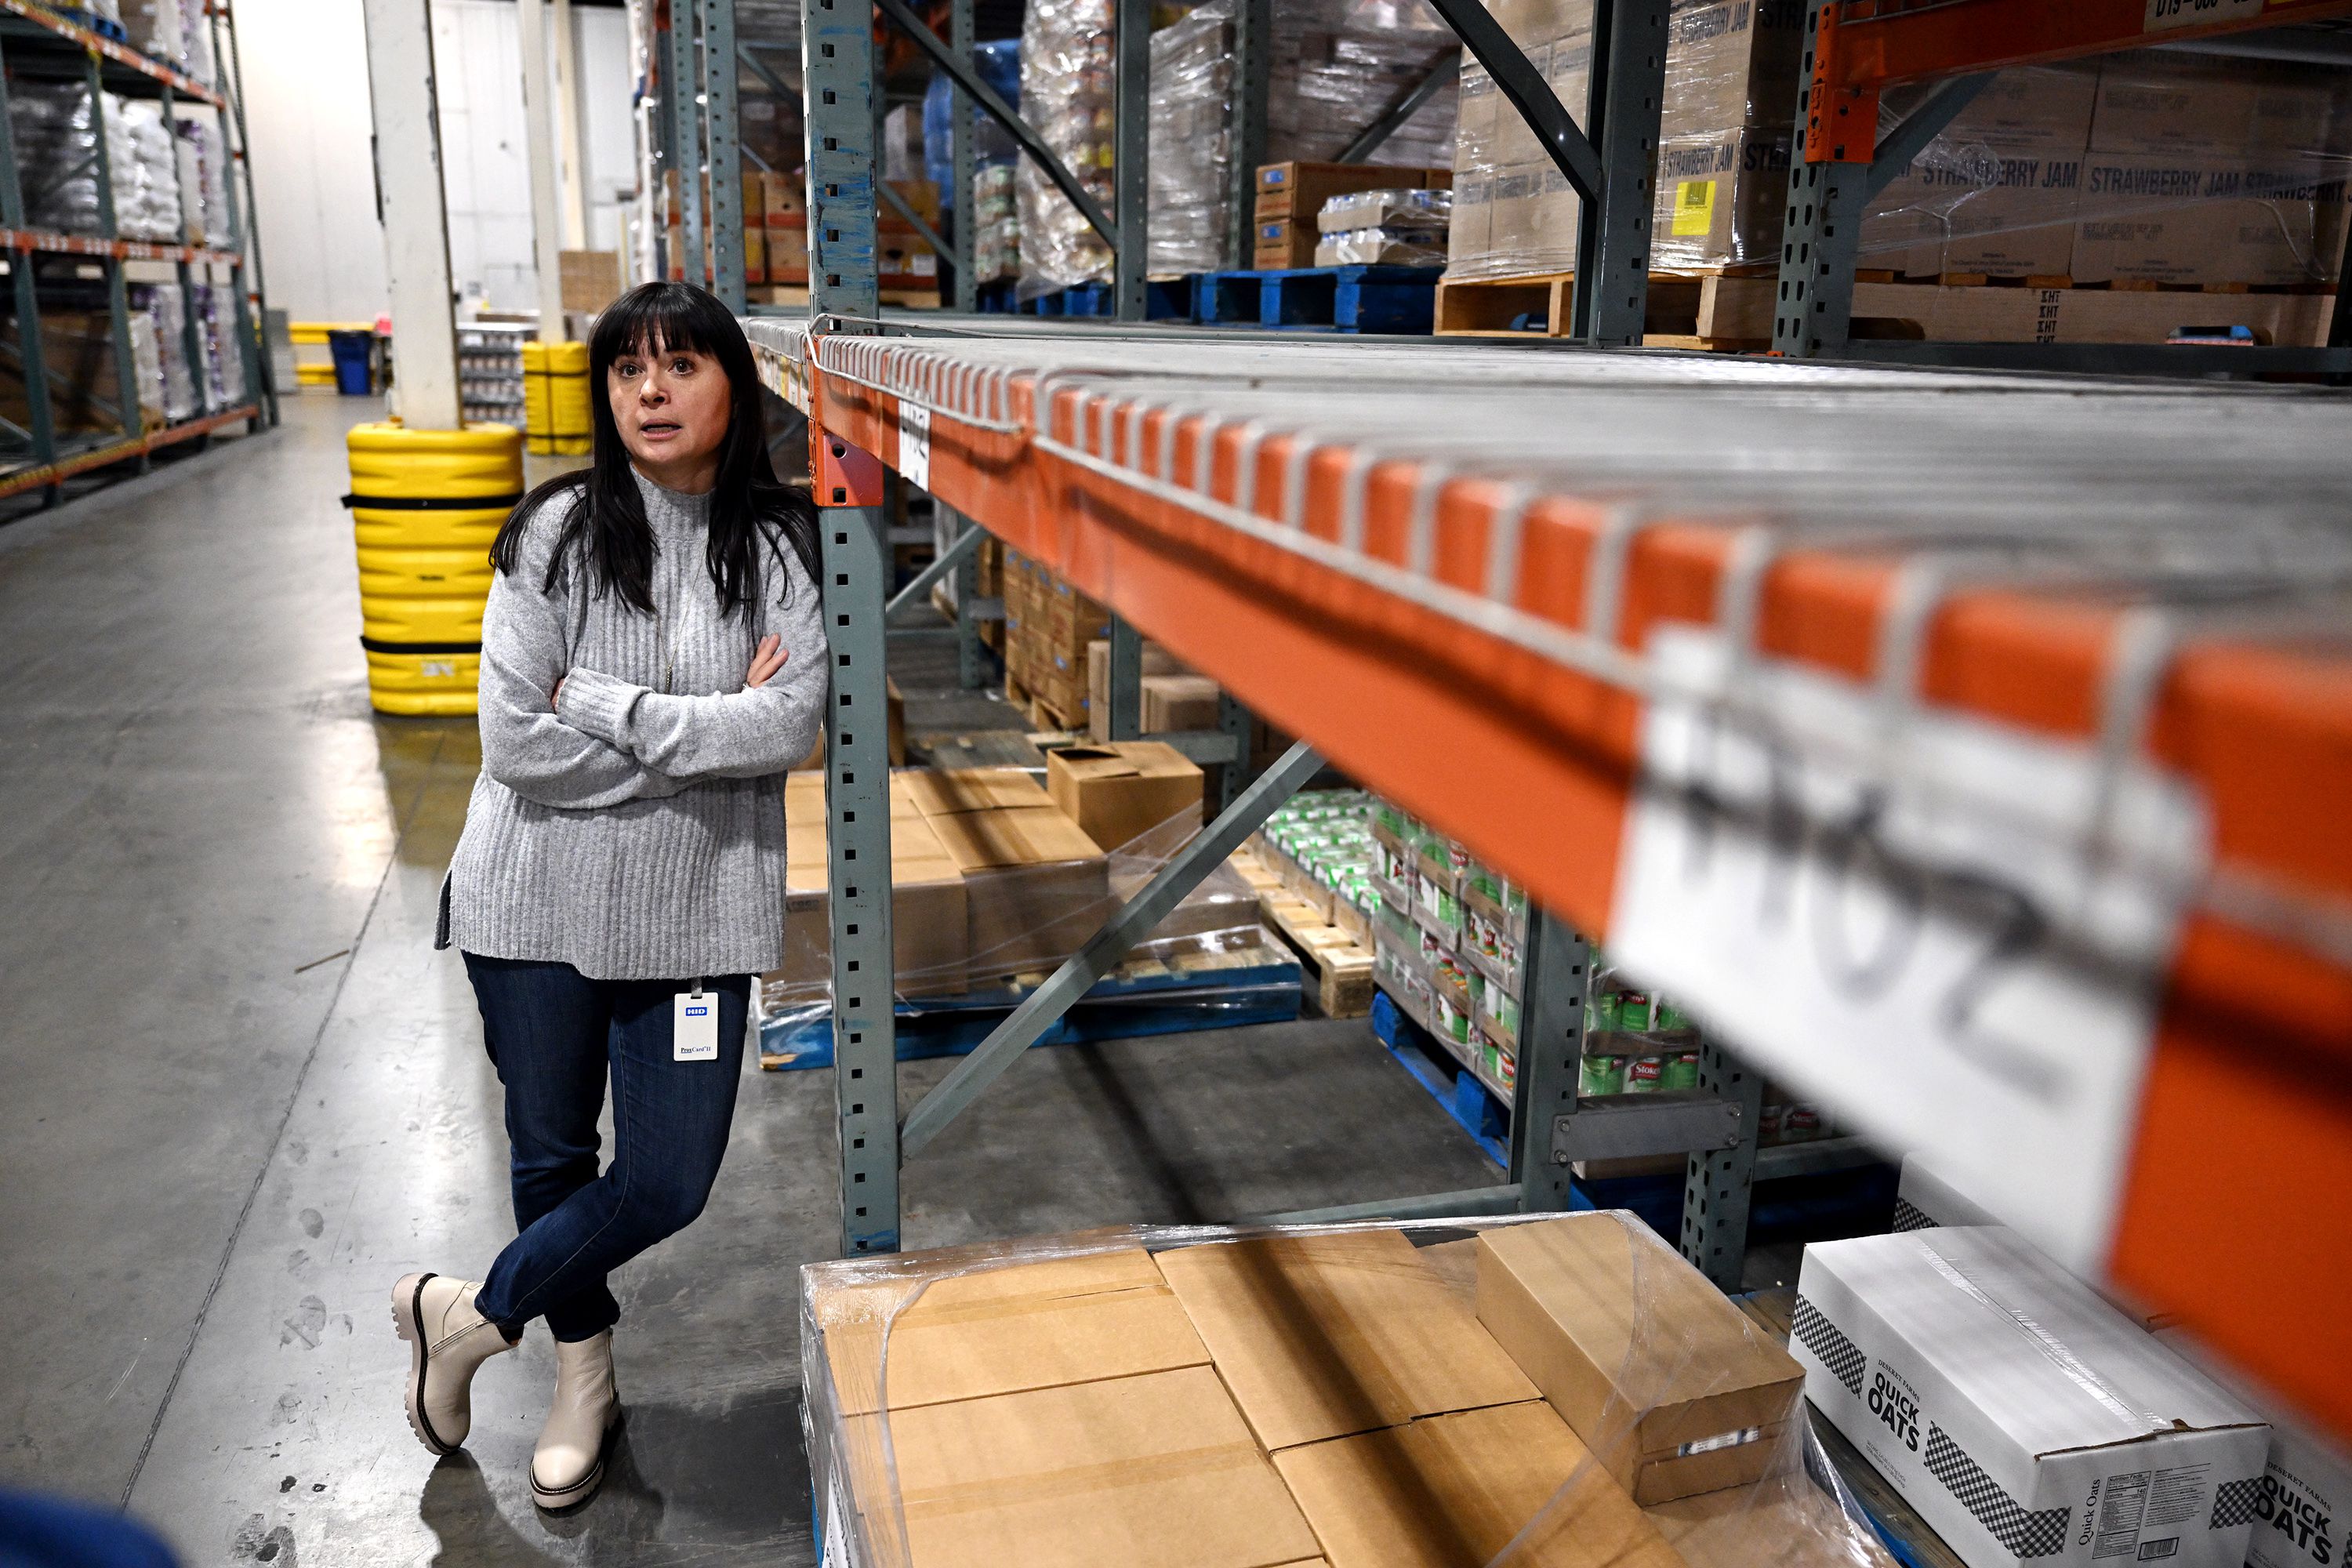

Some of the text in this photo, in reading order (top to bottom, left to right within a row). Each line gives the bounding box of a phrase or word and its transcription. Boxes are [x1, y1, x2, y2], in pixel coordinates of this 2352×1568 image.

[1731, 2, 1750, 32] JAM
[1667, 143, 1734, 178] STRAWBERRY JAM
[1923, 160, 2078, 189] STRAWBERRY JAM
[2089, 167, 2240, 198] STRAWBERRY JAM
[1875, 1372, 1919, 1425] QUICK
[1878, 1359, 1920, 1403] DESERET FARMS
[1867, 1387, 1920, 1452] OATS
[2078, 1479, 2100, 1545] Quick Oats
[2263, 1475, 2331, 1537] QUICK
[2267, 1461, 2332, 1512] DESERET FARMS
[2256, 1491, 2332, 1565] OATS
